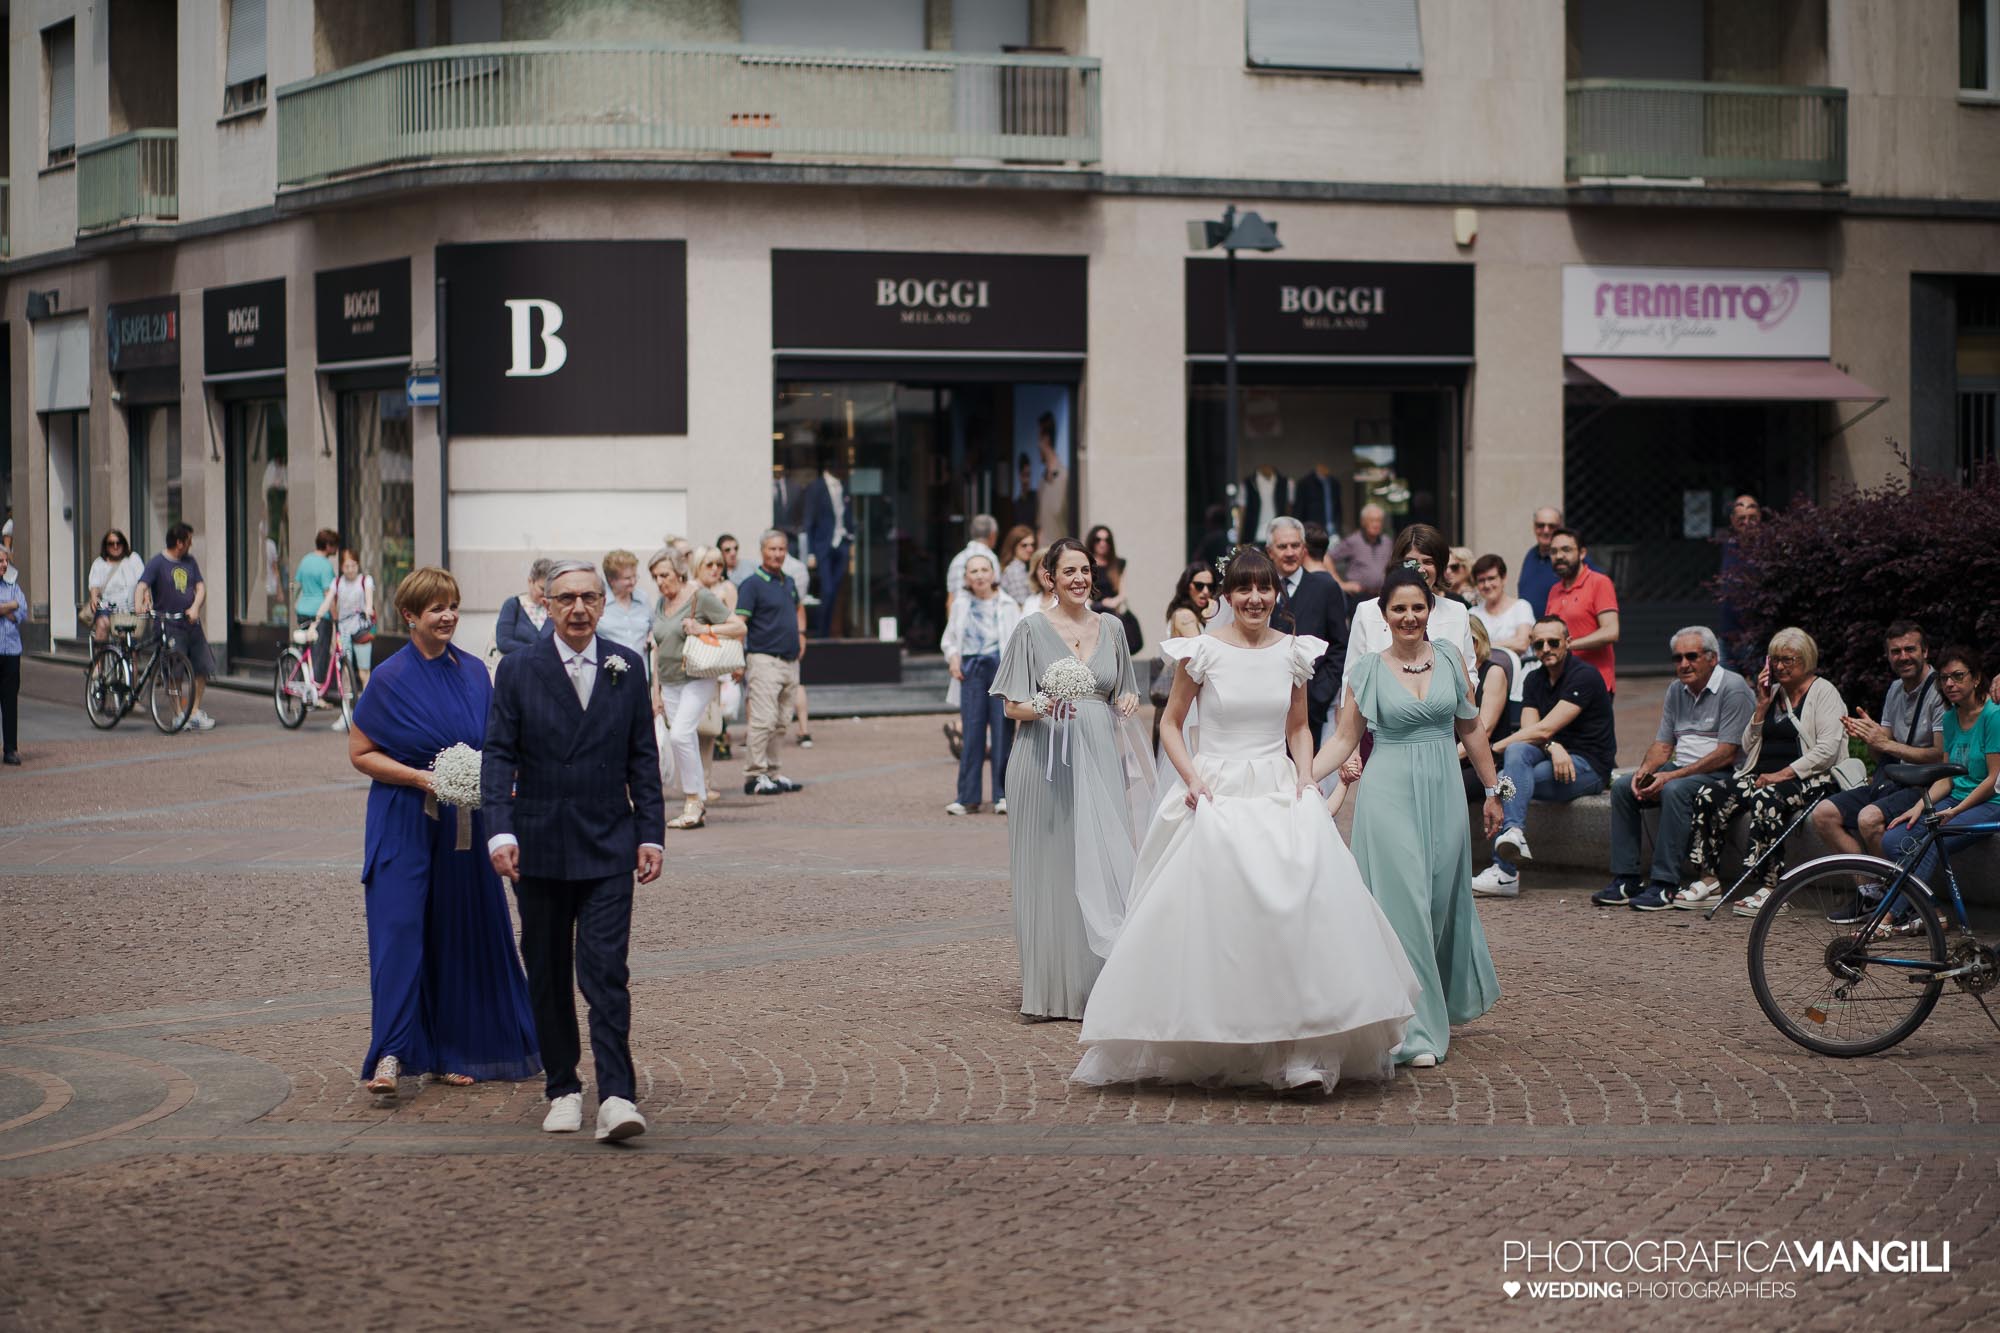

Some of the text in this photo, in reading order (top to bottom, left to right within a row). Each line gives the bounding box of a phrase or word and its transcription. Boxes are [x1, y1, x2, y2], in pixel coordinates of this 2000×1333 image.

[344, 289, 380, 320] BOGGI
[876, 279, 989, 307] BOGGI
[1280, 287, 1384, 313] BOGGI
[1595, 281, 1771, 320] FERMENTO
[227, 306, 260, 334] BOGGI
[901, 311, 971, 324] MILANO
[504, 299, 568, 377] B
